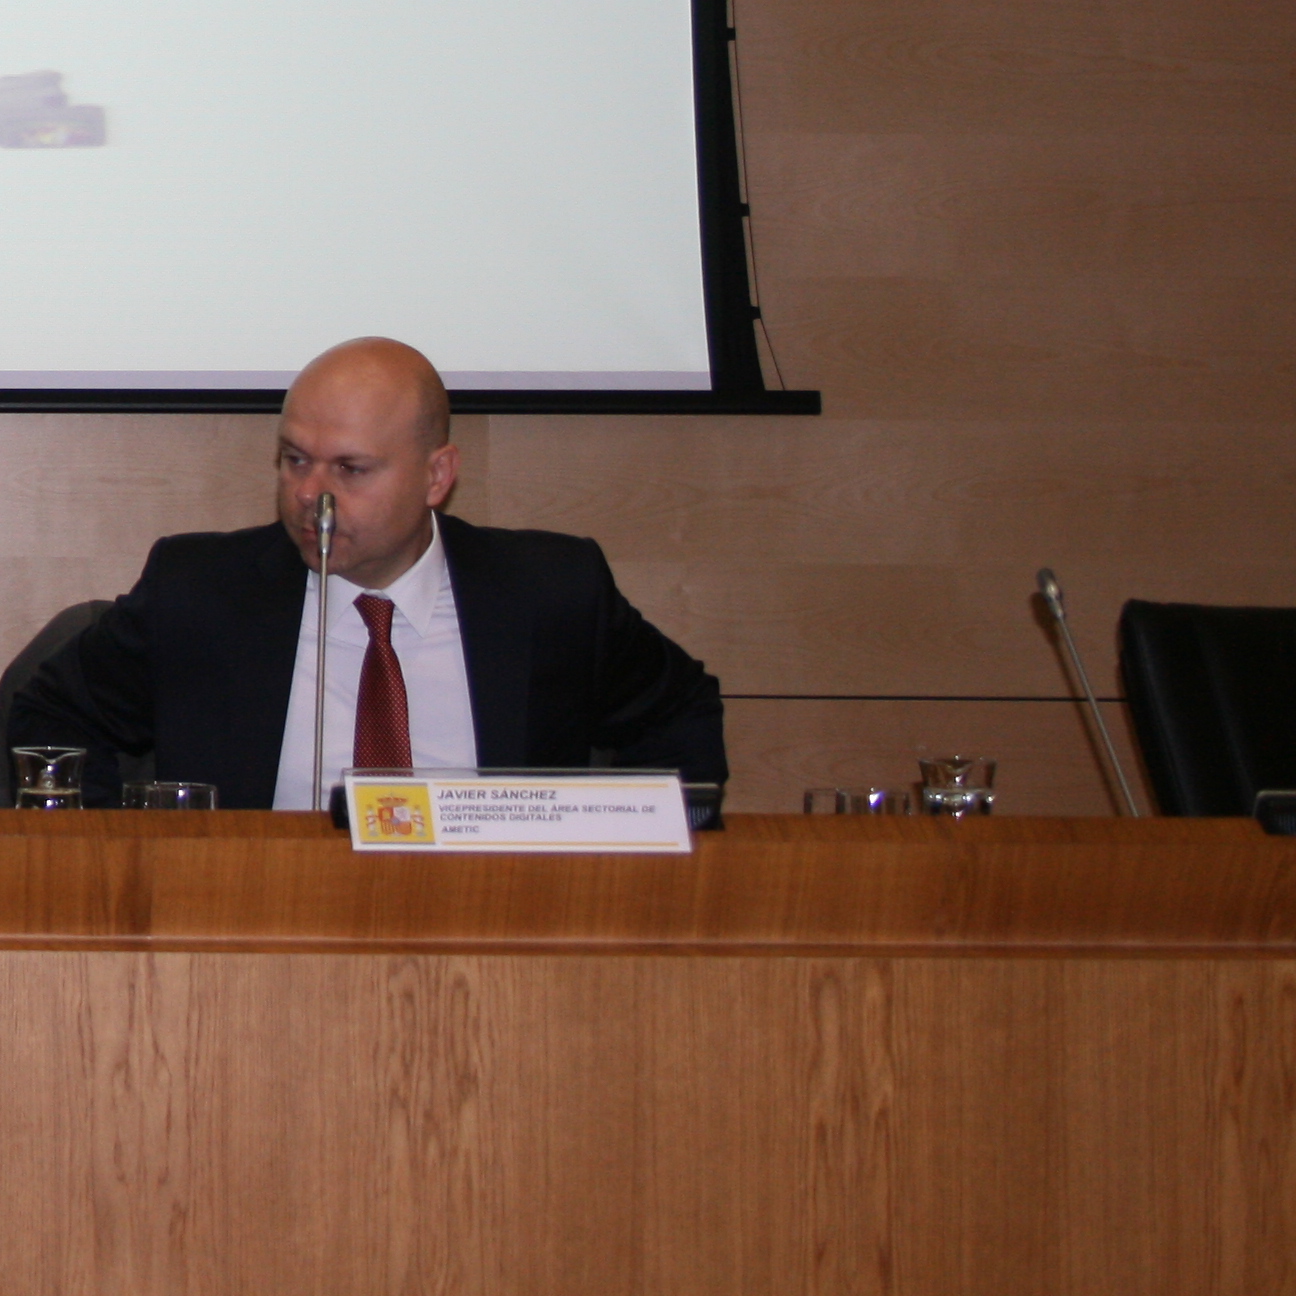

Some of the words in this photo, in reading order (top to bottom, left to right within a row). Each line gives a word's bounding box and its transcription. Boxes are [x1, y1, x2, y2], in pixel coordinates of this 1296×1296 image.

[436, 789, 487, 800] JAVIER
[490, 787, 557, 800] SÁNCHEZ
[439, 804, 525, 814] VICEPRESIDENTE
[528, 804, 548, 813] DEL
[581, 804, 638, 814] SECTORIAL
[641, 805, 656, 814] DE
[440, 813, 506, 822] CONTENIDOS
[509, 813, 562, 822] DIGITALES
